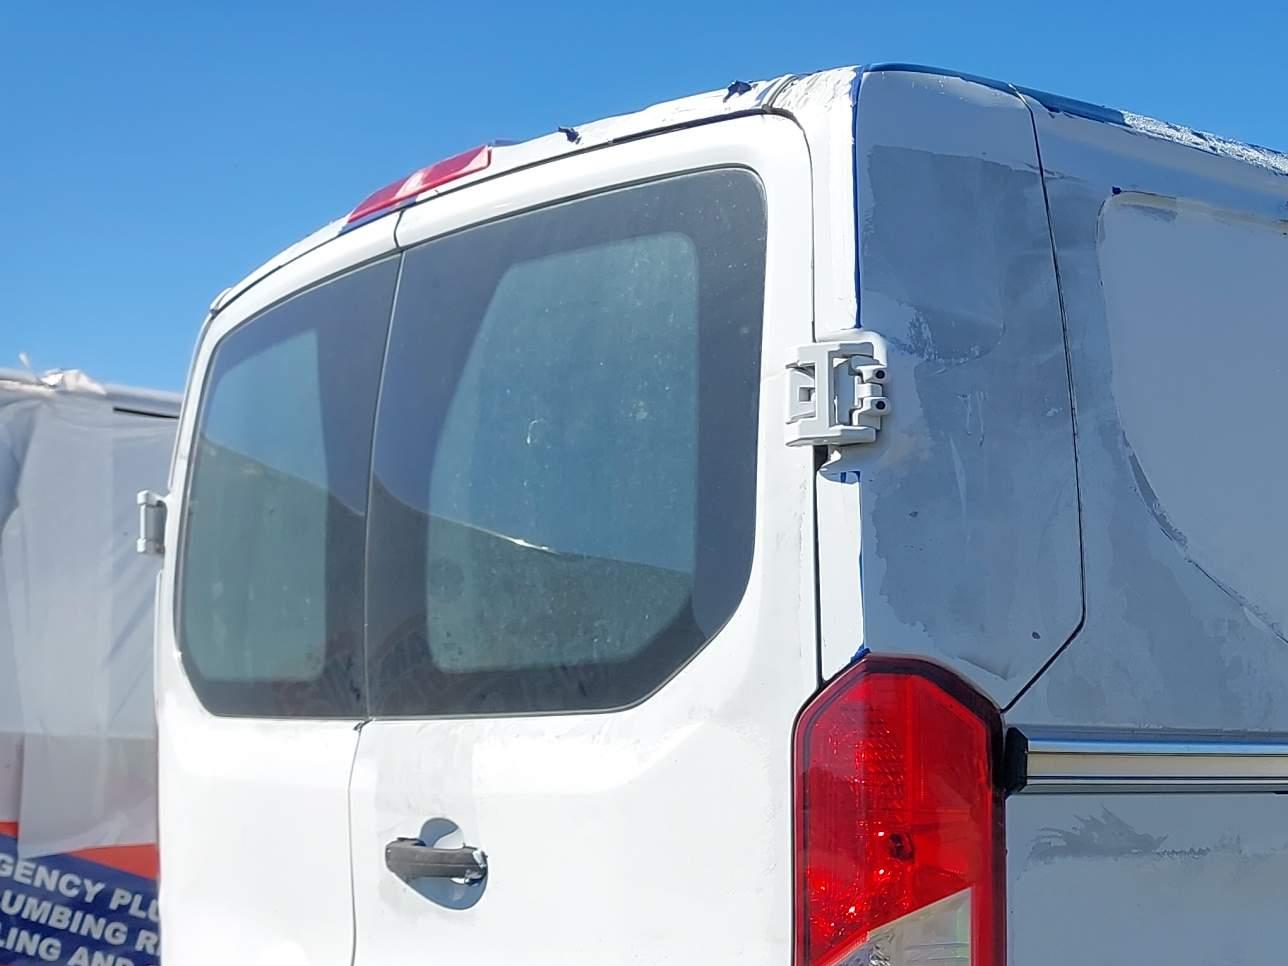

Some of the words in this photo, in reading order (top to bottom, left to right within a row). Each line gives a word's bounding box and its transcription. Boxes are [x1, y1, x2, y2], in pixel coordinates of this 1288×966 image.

[0, 852, 106, 904] GENCY
[0, 889, 128, 946] UMBING
[135, 929, 161, 956] R
[0, 921, 62, 962] ING
